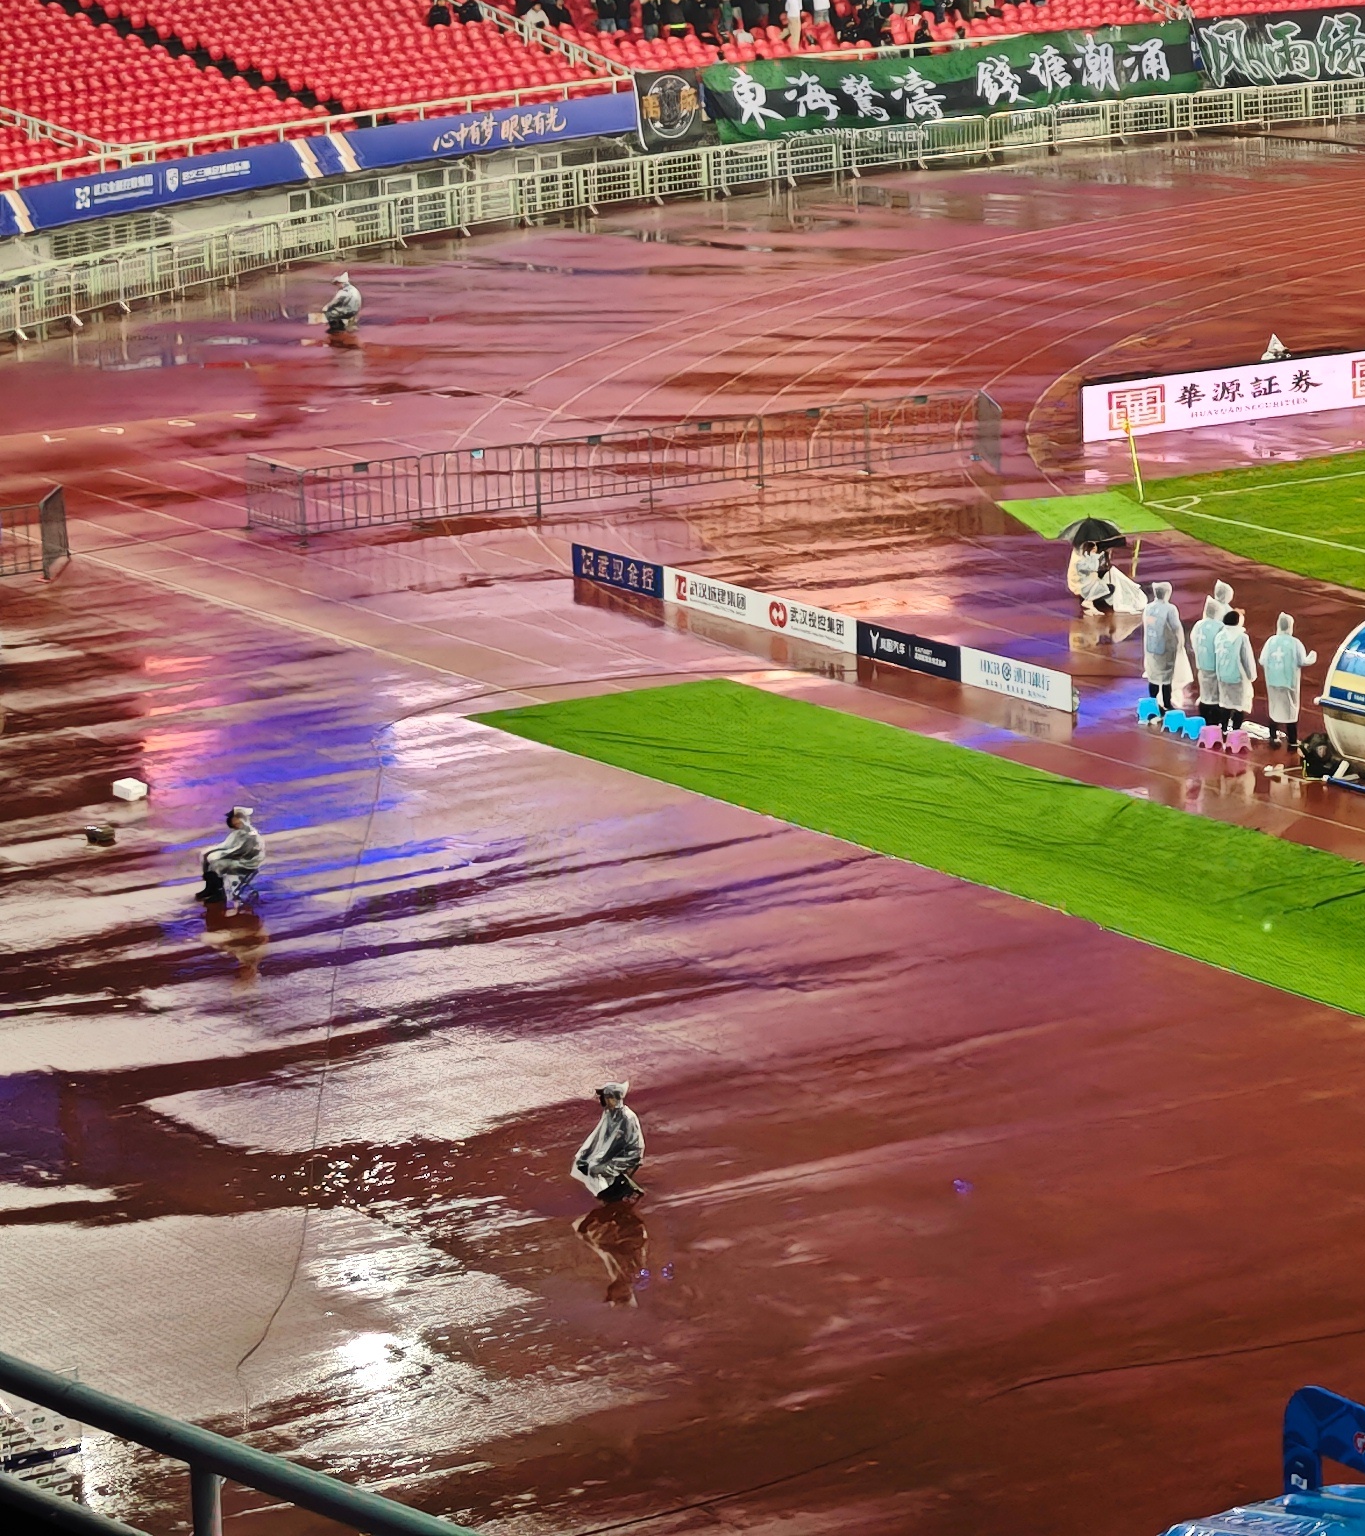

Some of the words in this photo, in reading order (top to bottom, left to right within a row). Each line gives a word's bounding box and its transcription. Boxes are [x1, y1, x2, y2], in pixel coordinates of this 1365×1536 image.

[729, 66, 947, 131] 東海驚濤
[432, 113, 498, 152] 心中有梦
[500, 105, 566, 143] 眼里有光
[1175, 369, 1323, 408] 華源証券
[689, 580, 747, 610] 武汉城建集团
[789, 606, 845, 637] 武汉投控集团
